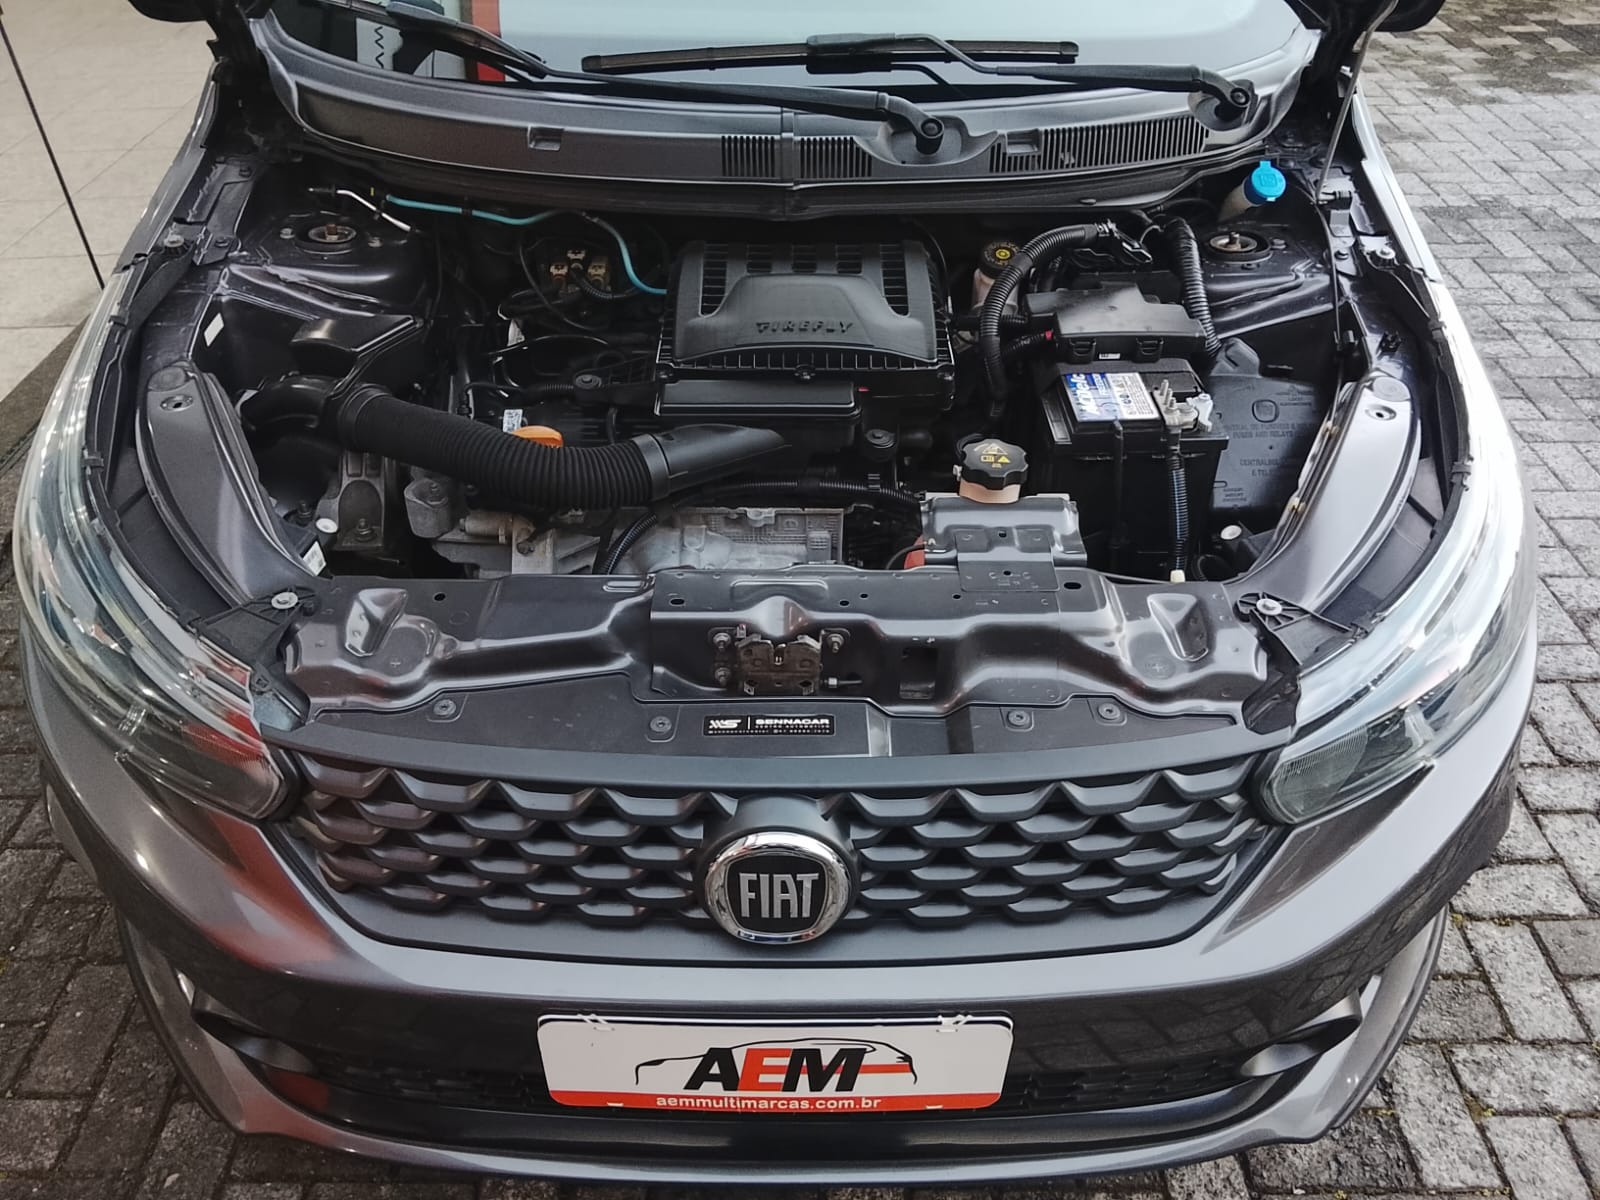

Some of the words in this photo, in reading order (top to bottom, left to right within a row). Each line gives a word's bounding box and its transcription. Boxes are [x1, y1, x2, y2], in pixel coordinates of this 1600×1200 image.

[756, 320, 853, 334] FIREFLY
[739, 872, 819, 918] FIAT
[683, 1047, 867, 1092] AEM
[655, 1095, 882, 1110] aemmultimarcas.com.br
